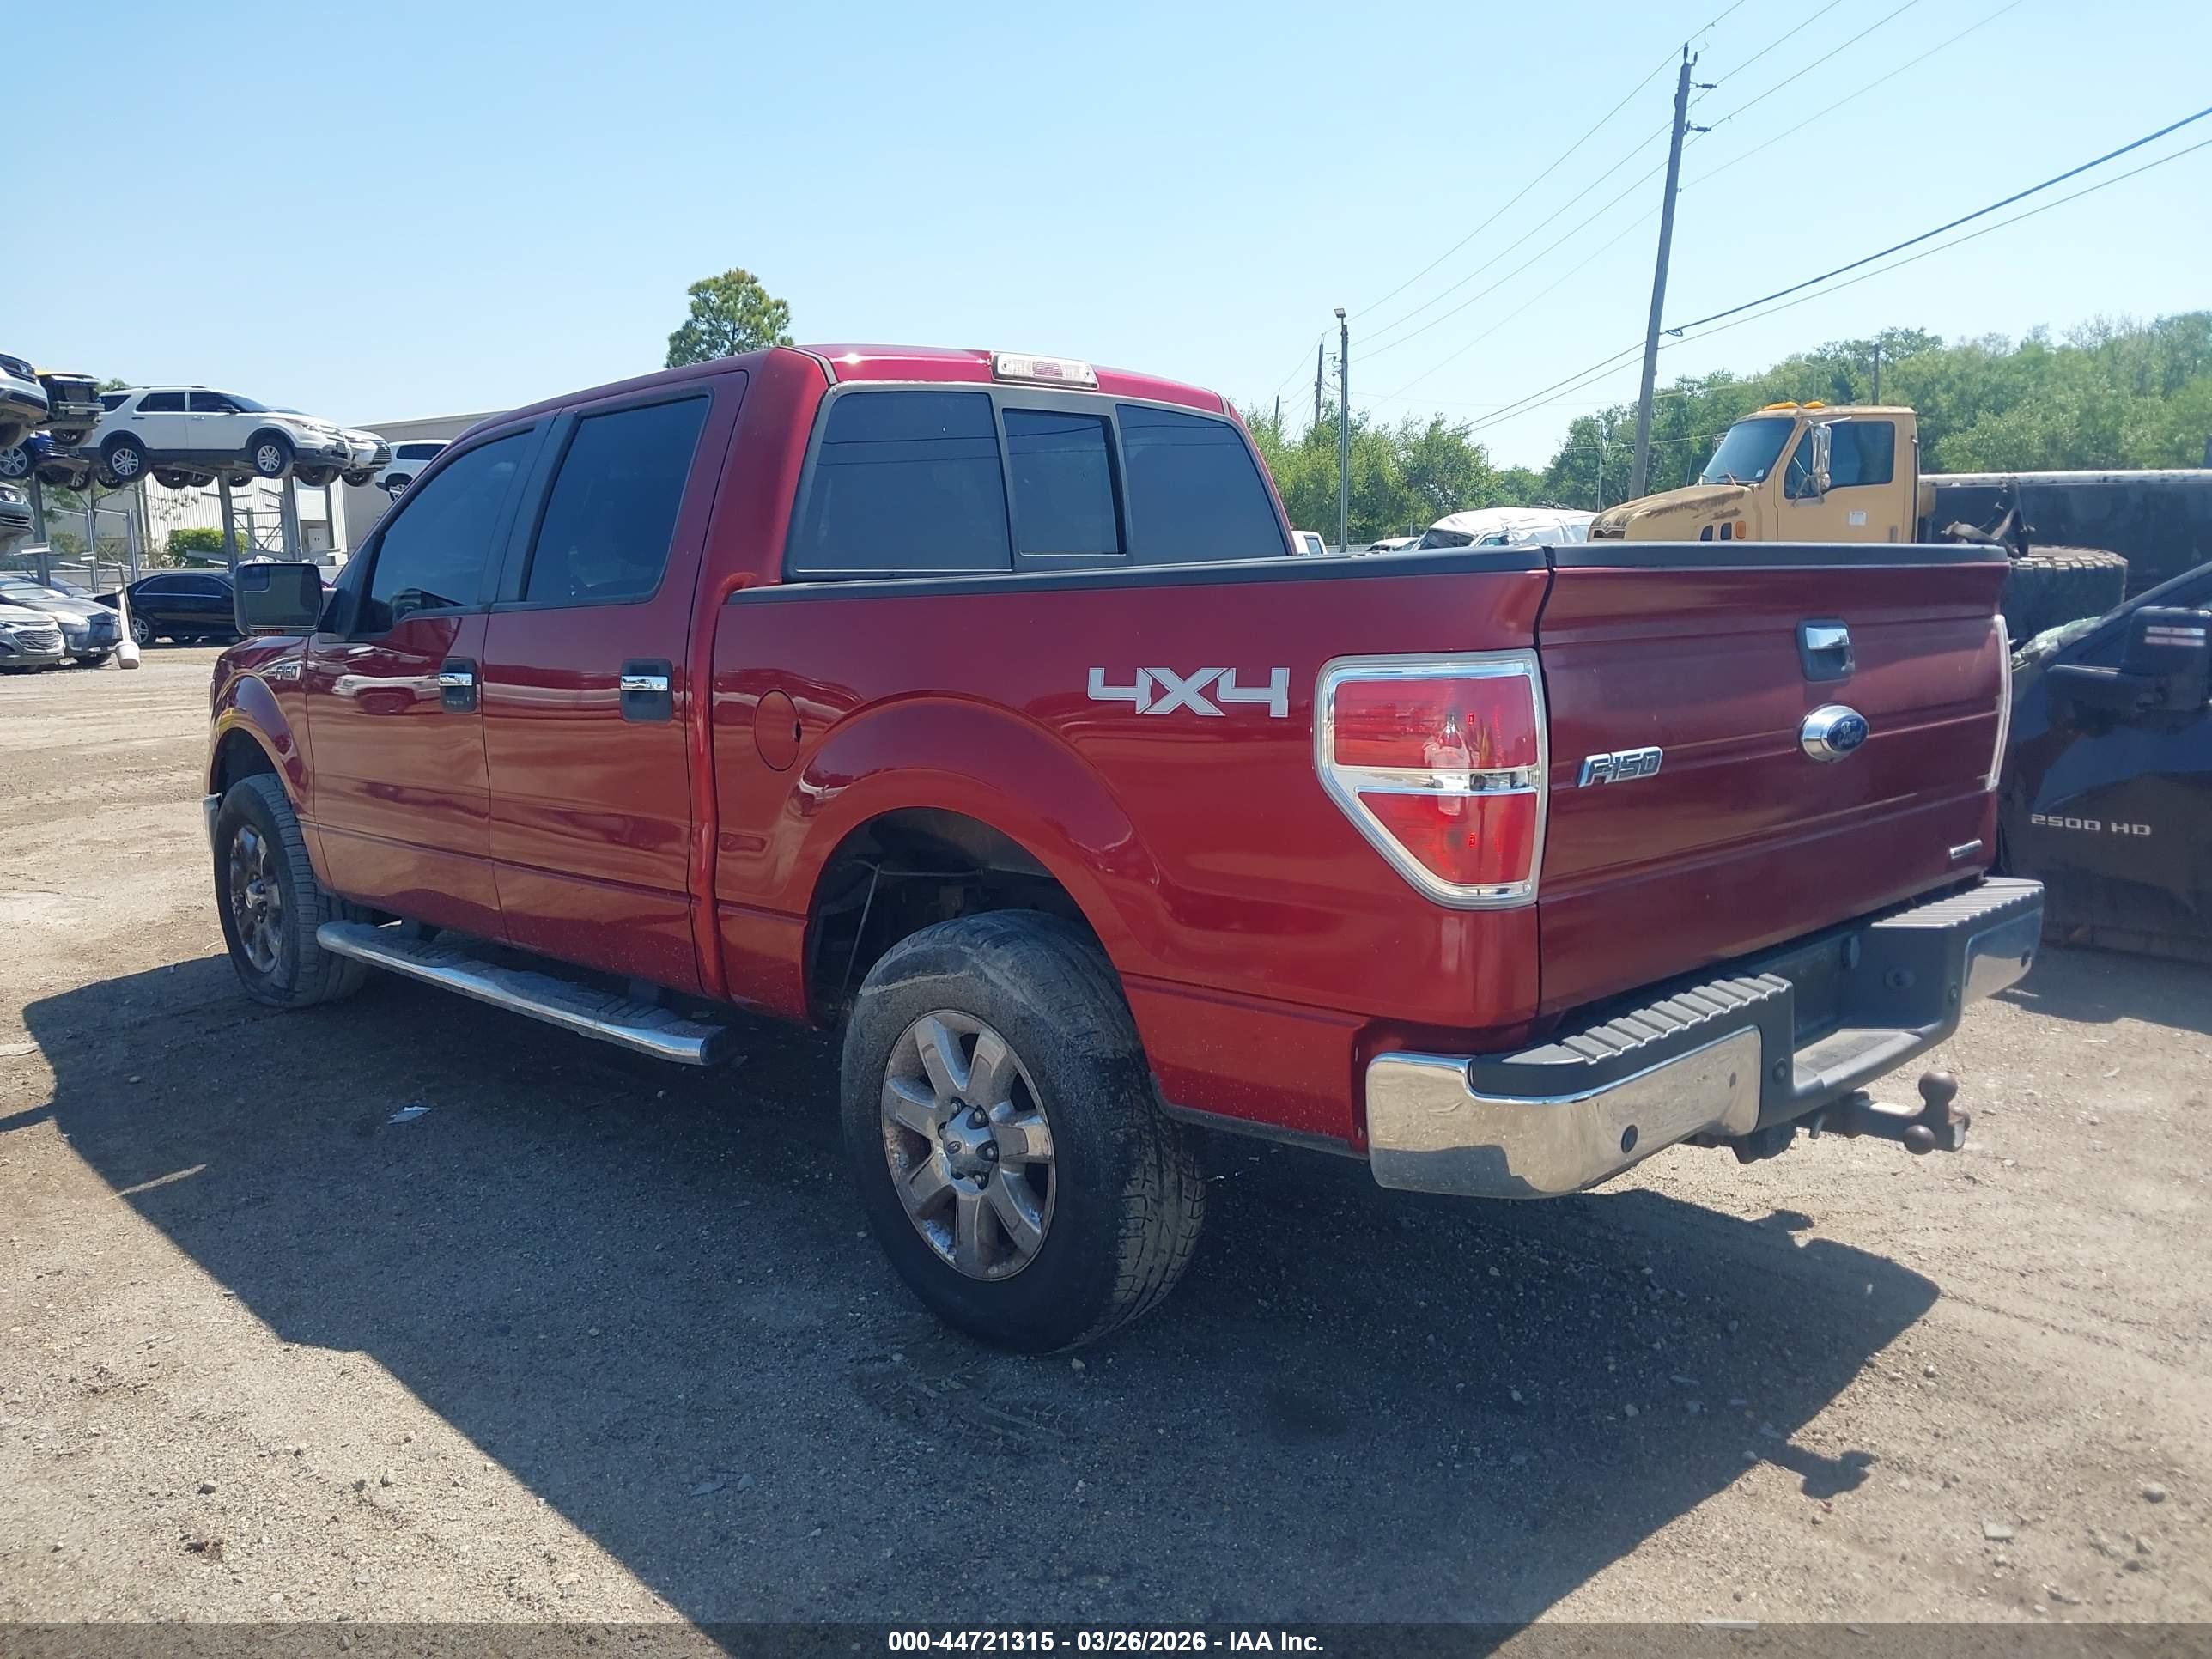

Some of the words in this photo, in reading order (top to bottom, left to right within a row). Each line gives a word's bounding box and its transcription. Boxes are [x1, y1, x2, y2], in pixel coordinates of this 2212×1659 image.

[1087, 667, 1291, 718] 4X4
[2031, 813, 2101, 831] 2500
[2111, 822, 2151, 836] HD
